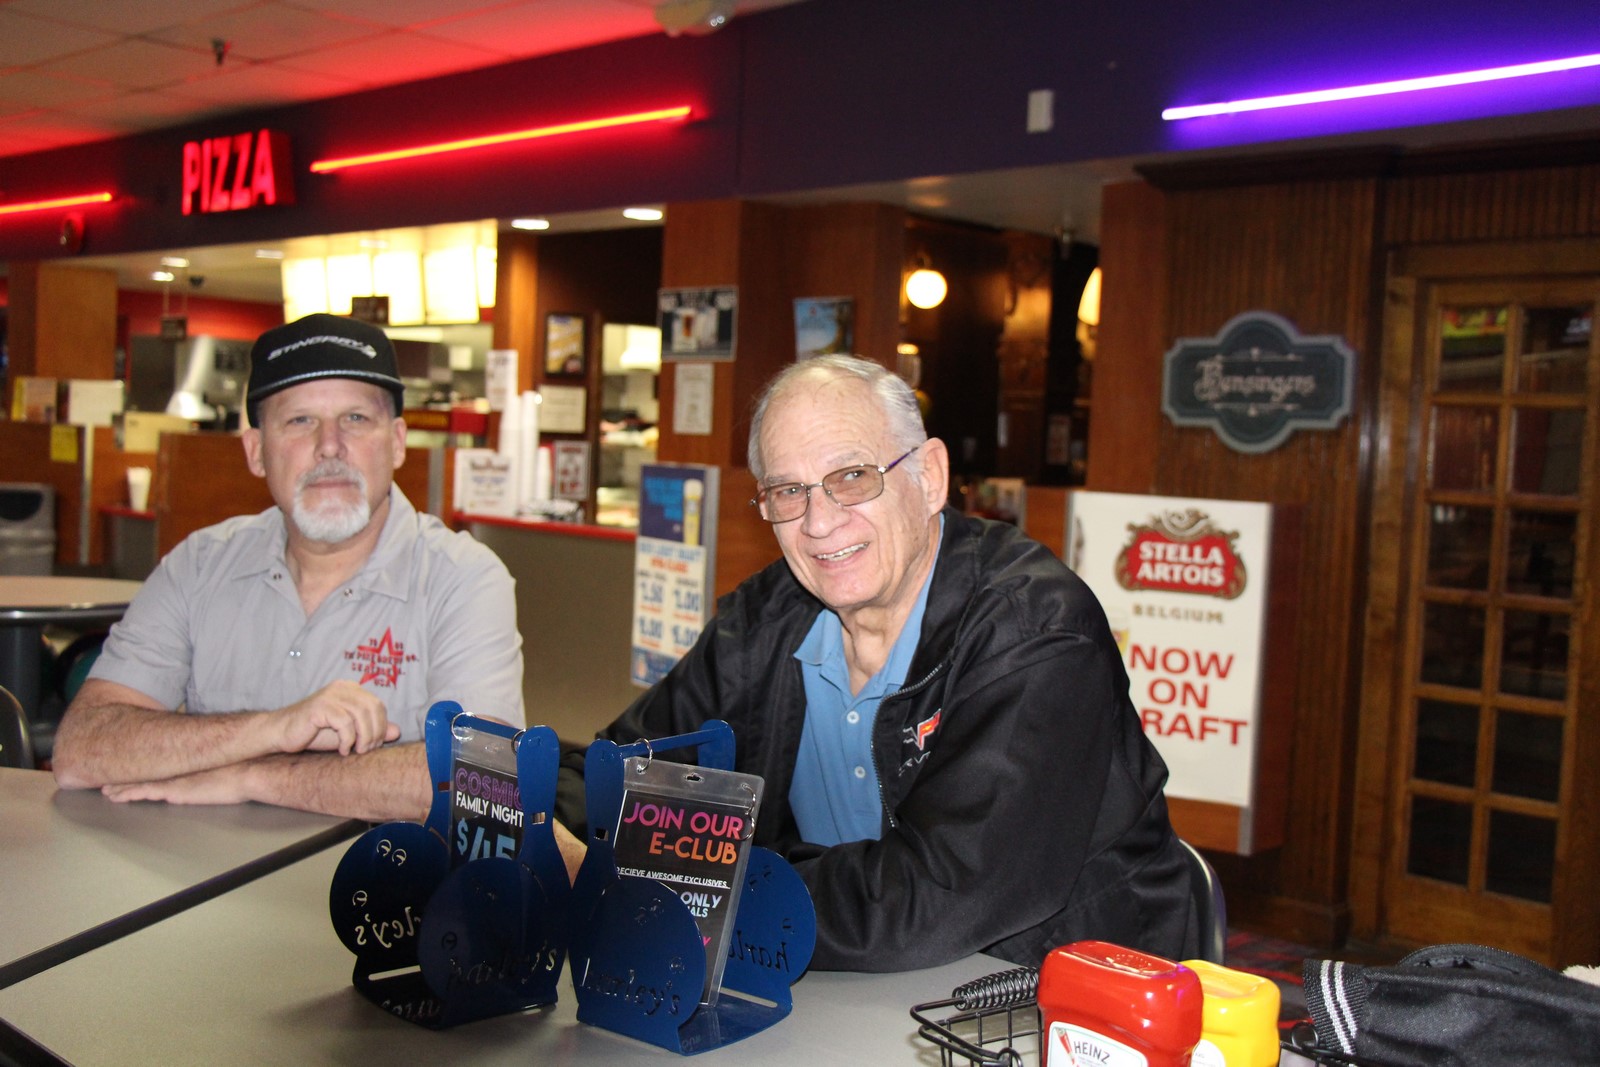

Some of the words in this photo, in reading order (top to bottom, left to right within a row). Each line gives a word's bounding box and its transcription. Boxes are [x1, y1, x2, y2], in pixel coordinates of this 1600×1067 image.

[182, 128, 276, 216] PIZZA
[1138, 541, 1224, 565] STELLA
[1136, 563, 1224, 586] ARTOIS
[1132, 604, 1224, 624] BELGIUM
[1130, 644, 1234, 679] NOW
[1148, 679, 1209, 709] ON
[1140, 708, 1248, 745] RAFT
[456, 790, 490, 816] FAMILY
[491, 803, 525, 828] NIGHT
[623, 802, 686, 831] JOIN
[689, 811, 744, 840] OUR
[648, 831, 738, 865] E-CLUB
[646, 870, 684, 882] AWESOME
[680, 891, 723, 909] ONLY
[1073, 1040, 1111, 1065] HEINZ
